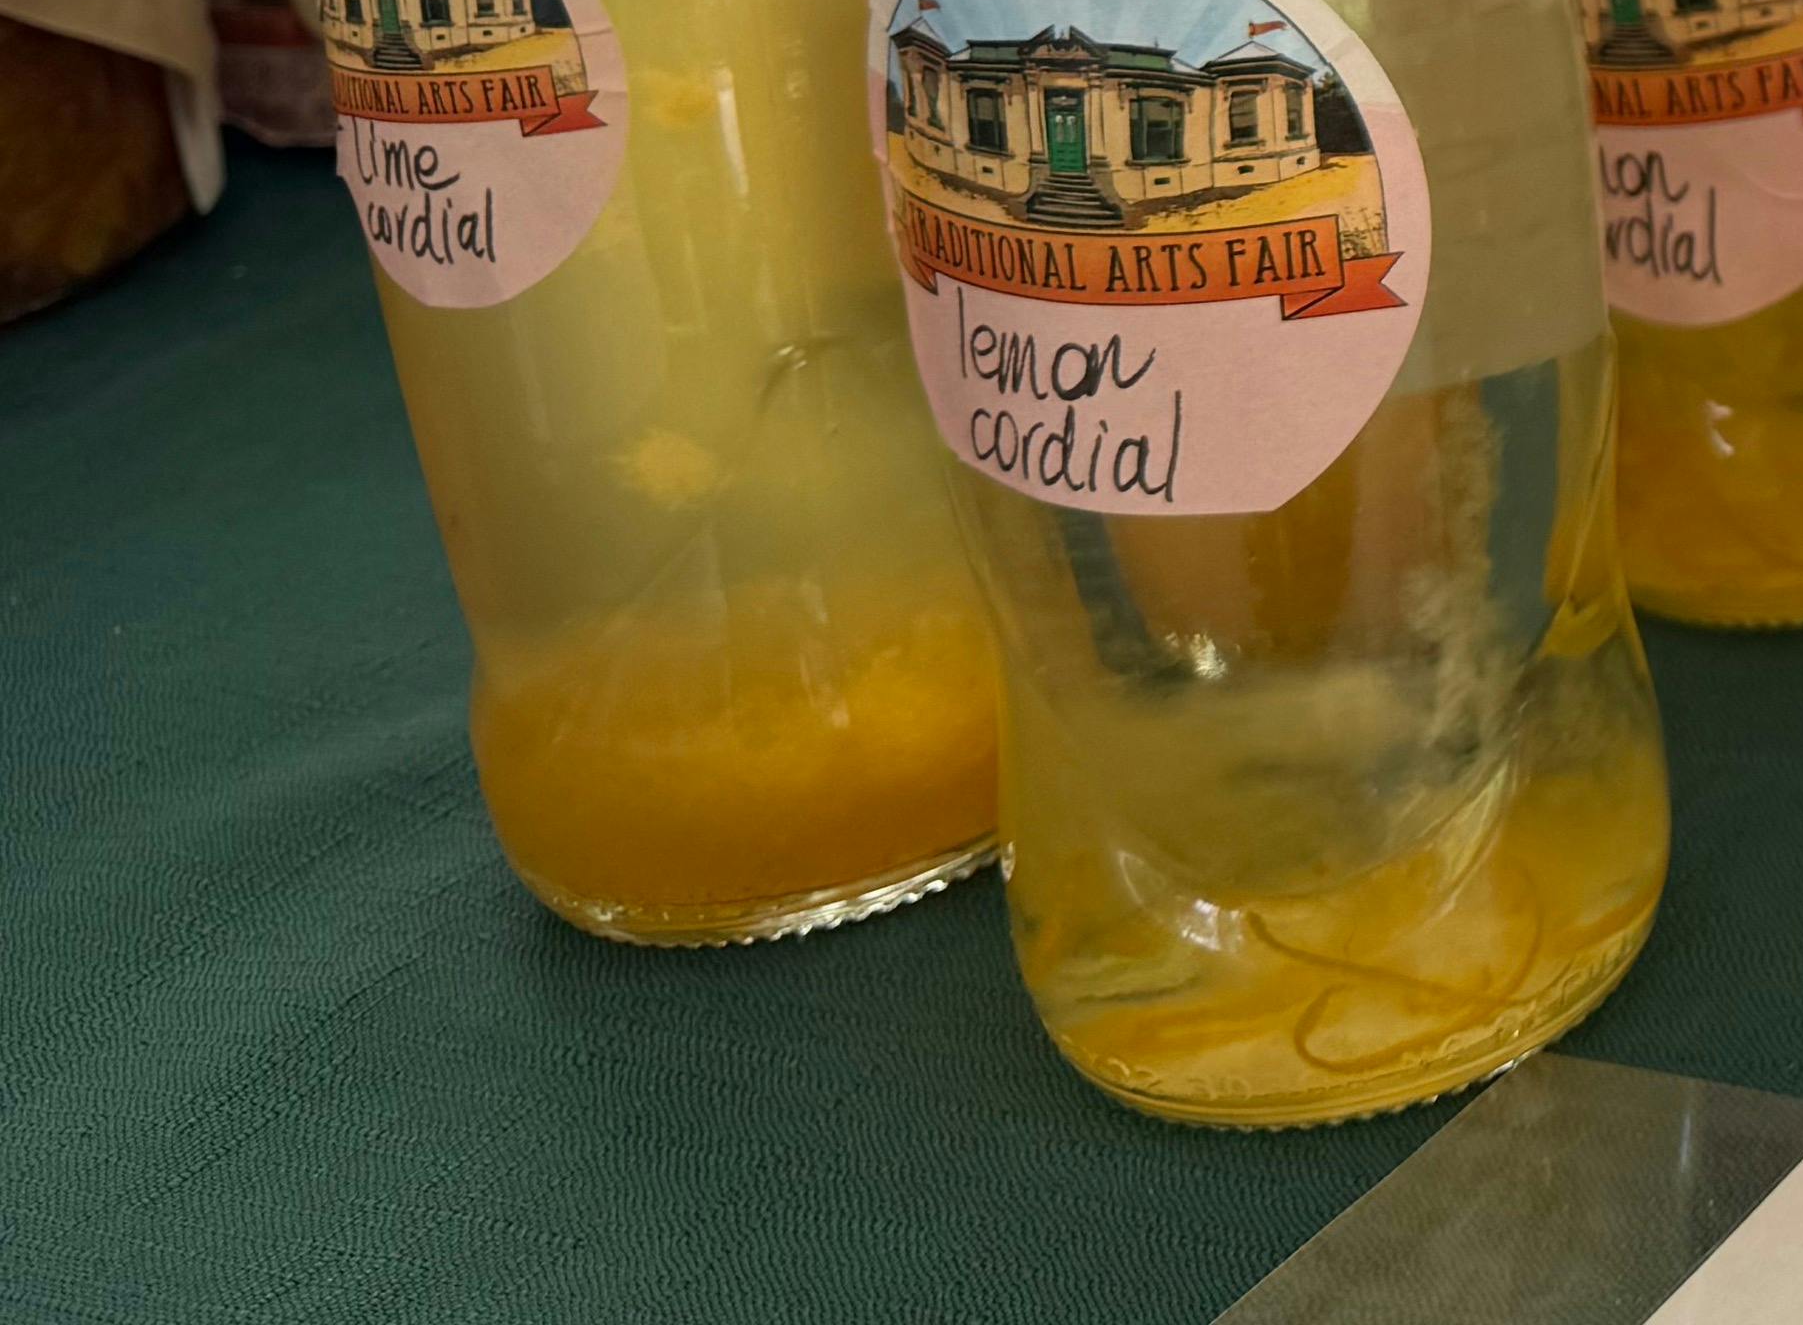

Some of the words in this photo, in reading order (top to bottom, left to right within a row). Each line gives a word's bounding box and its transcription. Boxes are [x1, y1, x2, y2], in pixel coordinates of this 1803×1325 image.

[416, 81, 474, 115] ARTS
[481, 74, 547, 112] FAIR
[1666, 71, 1747, 118] ARTS
[353, 116, 460, 191] lime
[368, 188, 495, 264] cordial
[908, 201, 1087, 291] TRADITIONAL
[1106, 244, 1208, 294] ARTS
[1227, 229, 1326, 287] FAIR
[1606, 187, 1722, 285] rdial
[957, 286, 1156, 400] lemon
[971, 390, 1182, 502] cordial
